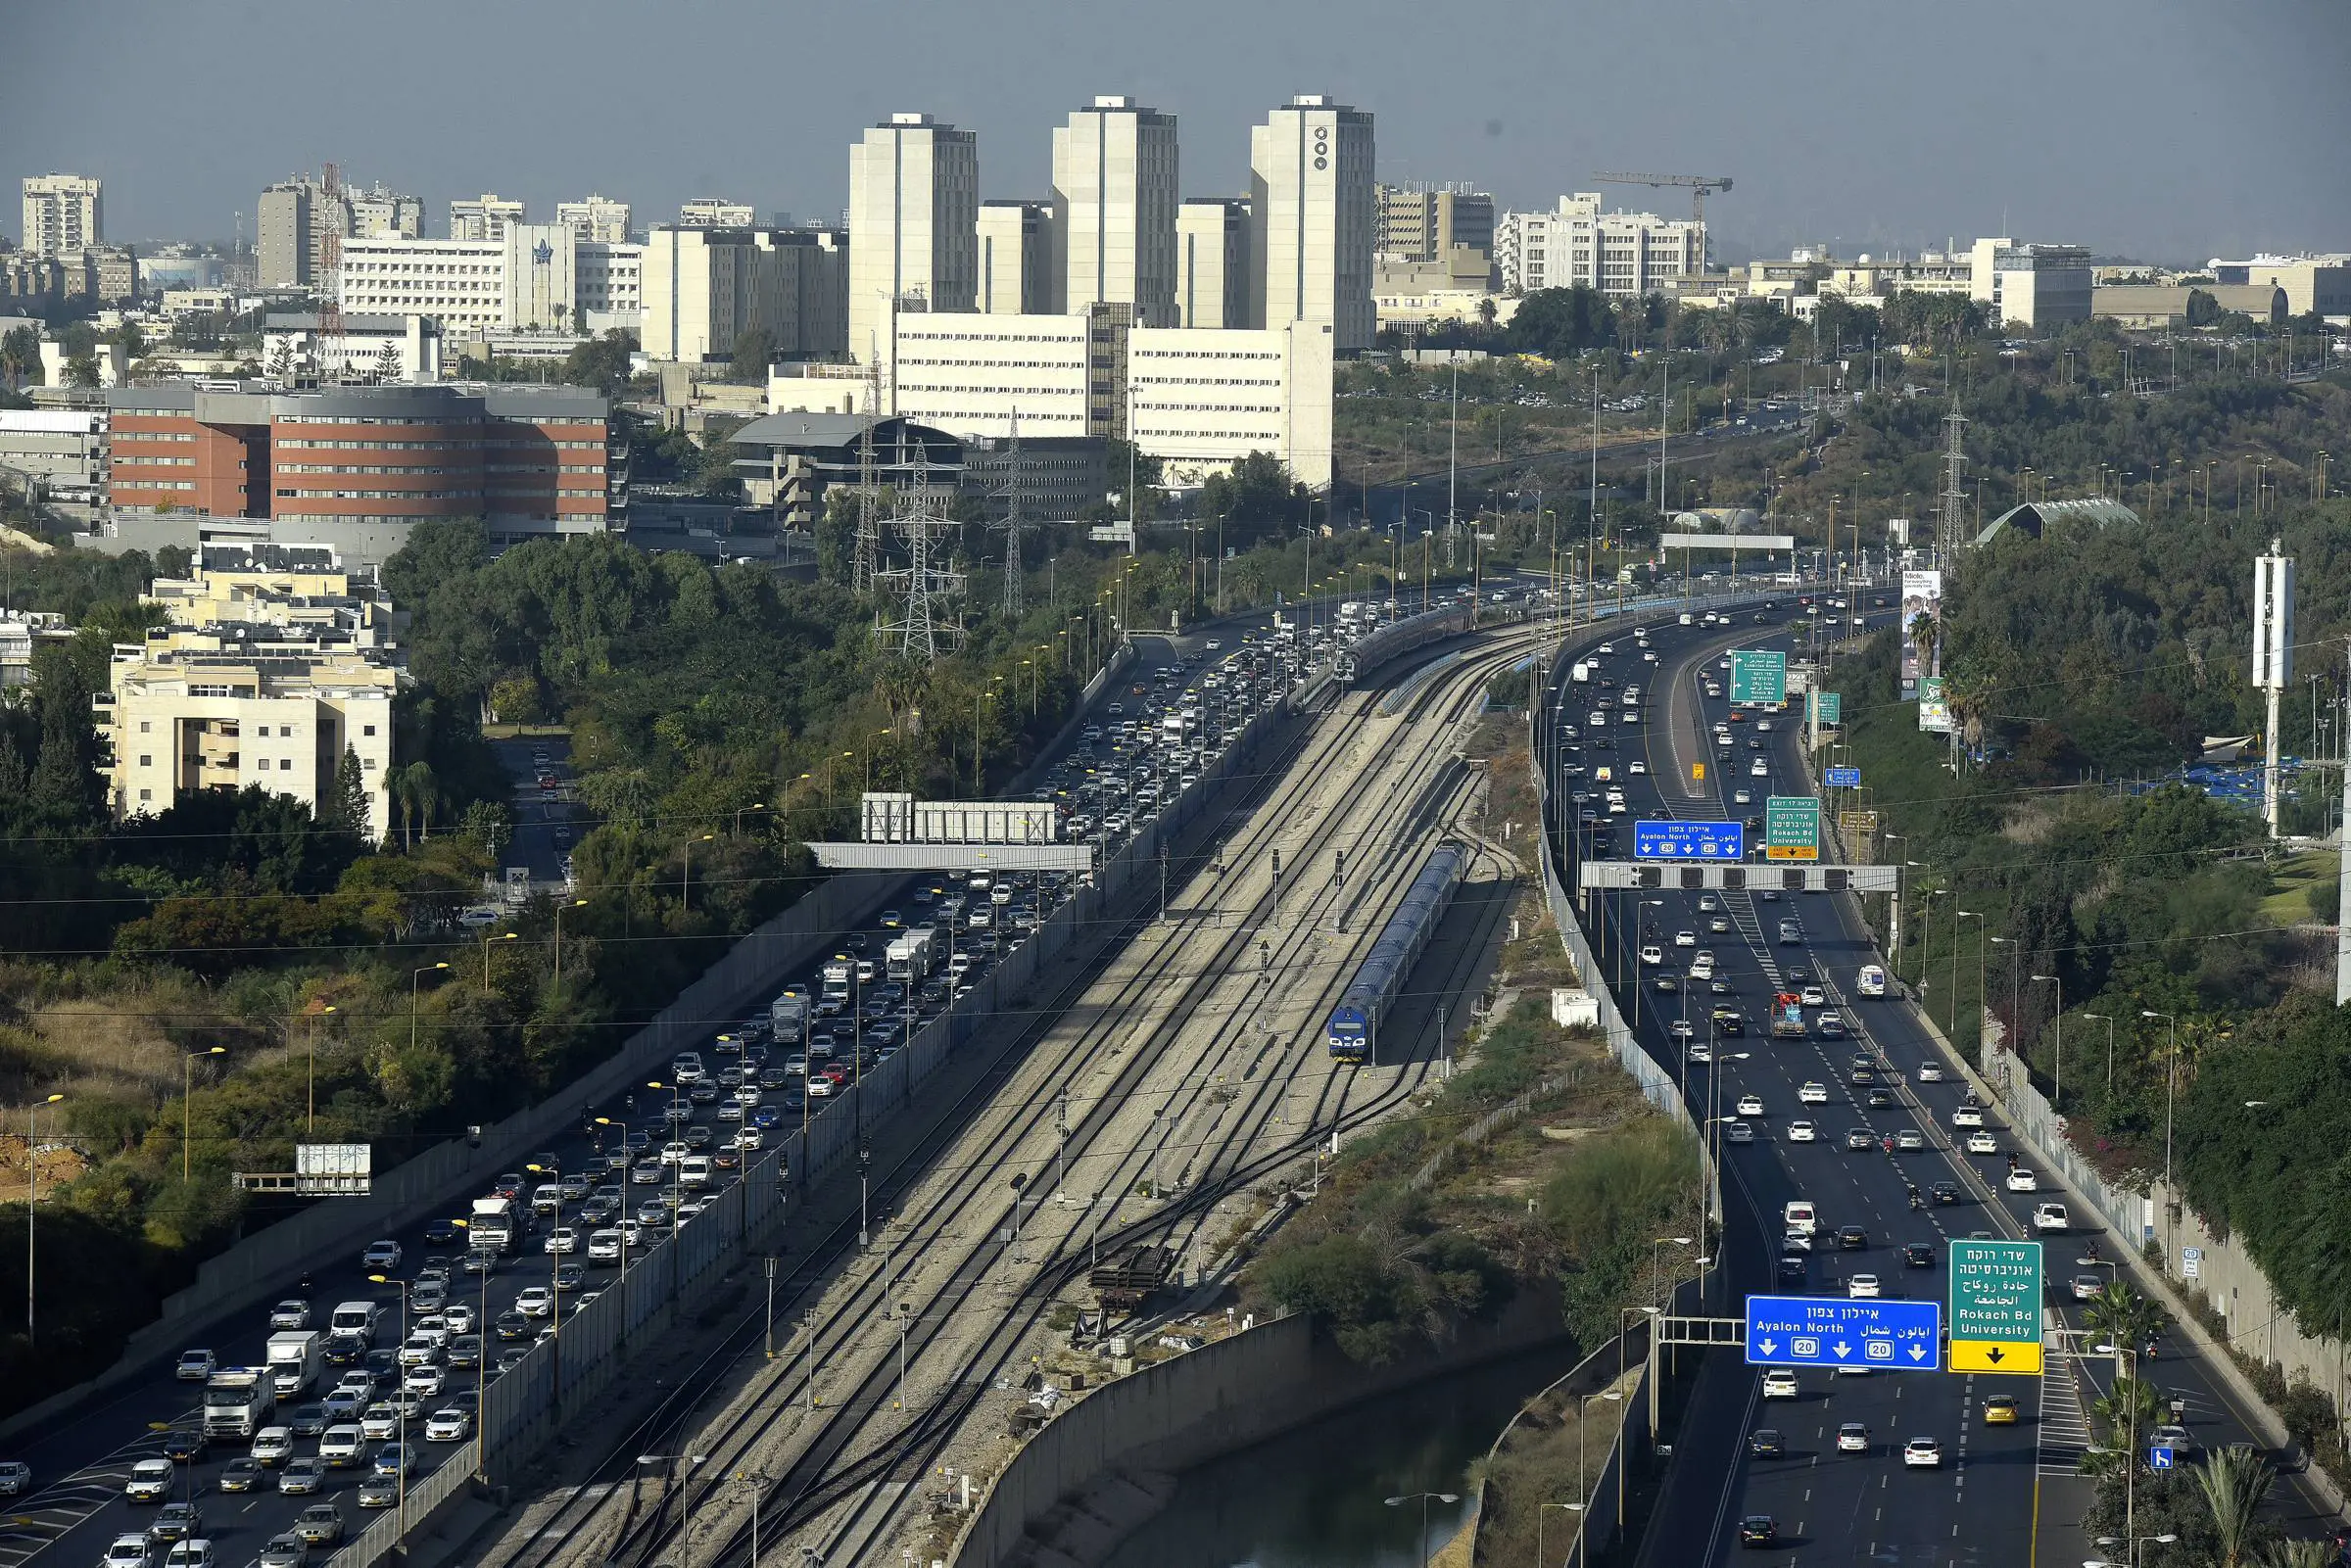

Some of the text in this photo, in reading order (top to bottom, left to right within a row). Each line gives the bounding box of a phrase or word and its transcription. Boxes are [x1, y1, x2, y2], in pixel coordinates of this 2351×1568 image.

[1966, 1250, 1996, 1261] רוקח
[1959, 1264, 2033, 1276] אוניברסיטה
[1962, 1279, 2030, 1293] جادة روكاح
[1974, 1294, 2019, 1307] الجامعة
[1806, 1307, 1880, 1320] איילון צפון
[1959, 1308, 2033, 1321] Rokach Bd
[1756, 1320, 1845, 1334] Ayalon North
[1860, 1324, 1930, 1340] ايالون شمال
[1961, 1323, 2031, 1338] University
[1798, 1342, 1812, 1352] 20
[1872, 1345, 1887, 1354] 20
